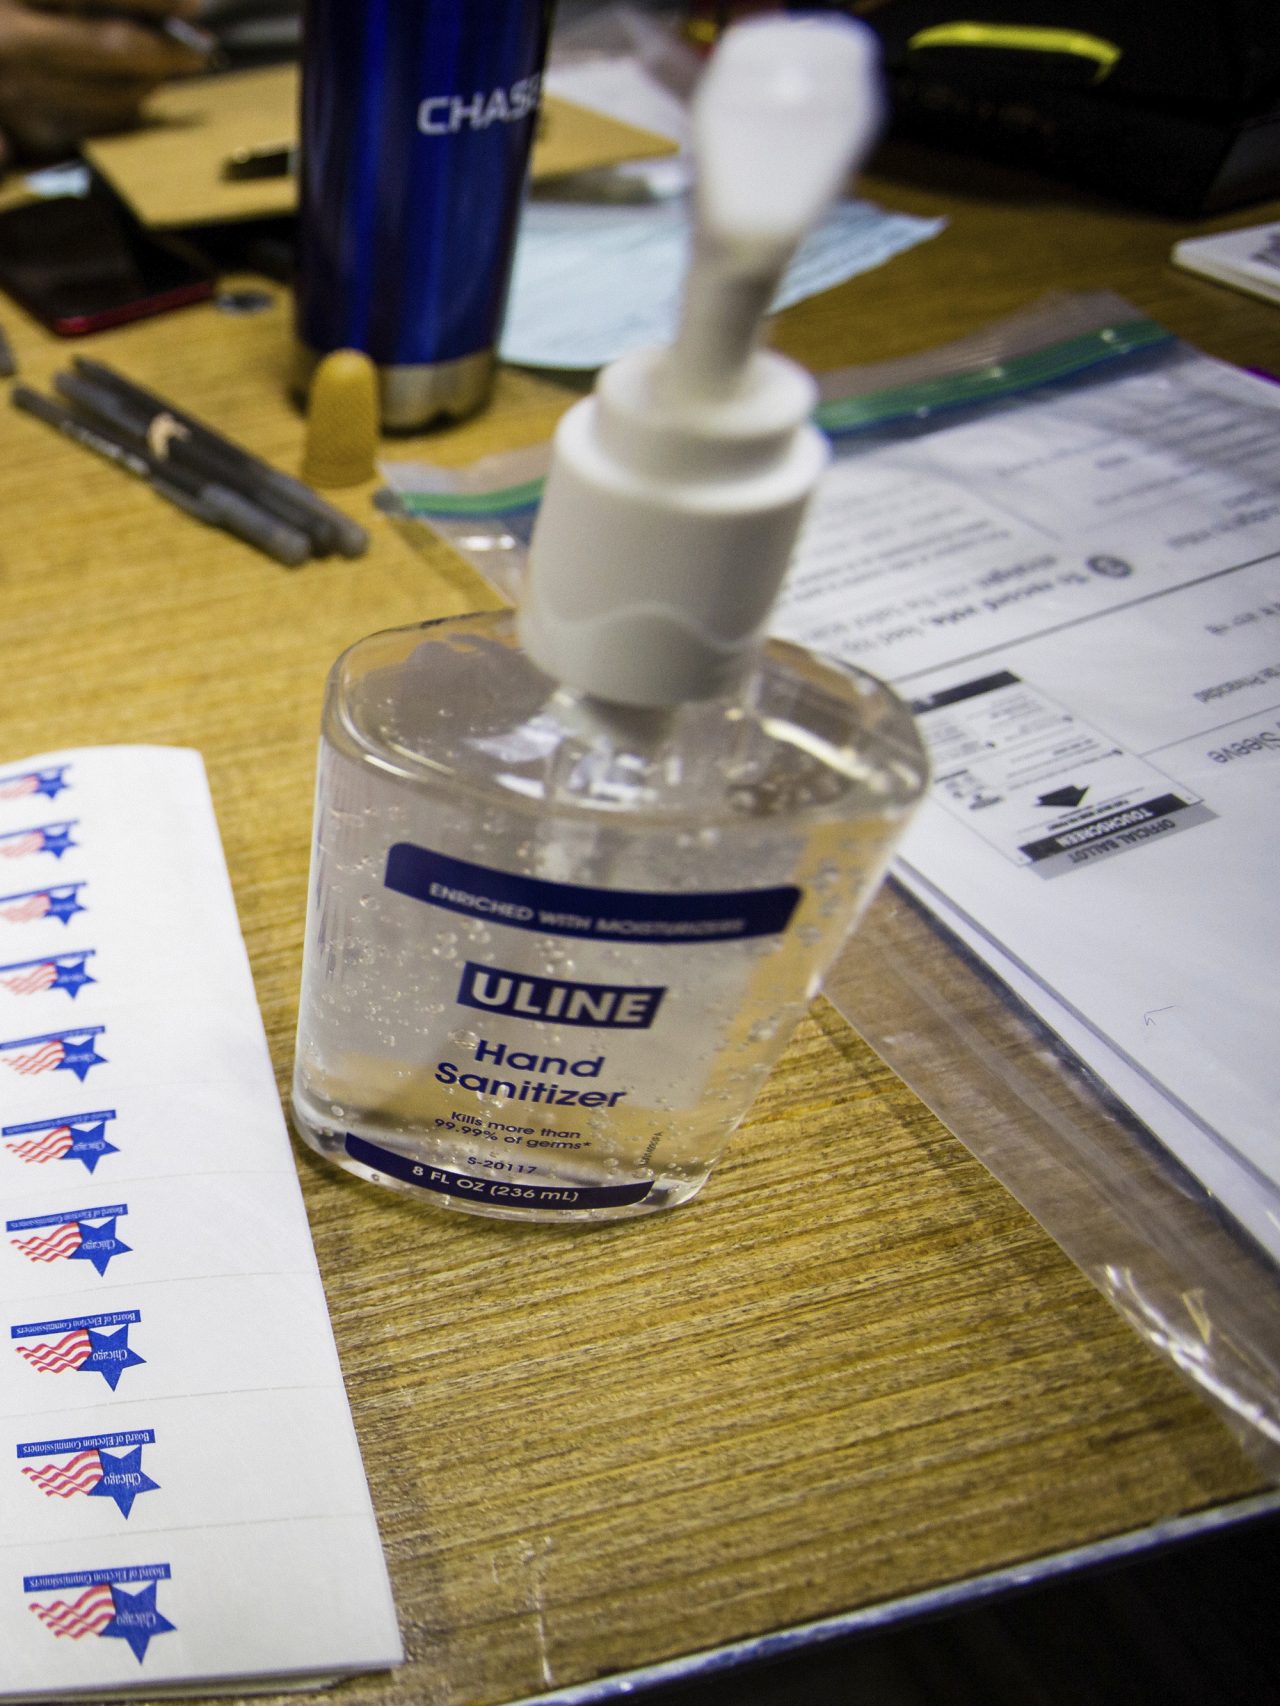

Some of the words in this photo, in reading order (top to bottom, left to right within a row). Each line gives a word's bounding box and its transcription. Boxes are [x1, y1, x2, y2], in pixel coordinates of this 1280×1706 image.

[1055, 808, 1154, 847] TOUCHSCREEN
[1118, 818, 1176, 845] OFFICIAL
[1065, 838, 1116, 864] BALLOT
[429, 881, 534, 921] ENRICHED
[538, 909, 592, 931] WITH
[471, 971, 653, 1024] ULINE
[474, 1039, 605, 1078] Hand
[434, 1062, 627, 1108] Sanitizer
[434, 1117, 498, 1142] 99.99%
[503, 1132, 522, 1145] of
[451, 1111, 483, 1127] Kills
[488, 1121, 535, 1139] more
[540, 1127, 581, 1140] than
[467, 1156, 537, 1174] S-20117
[412, 1165, 424, 1177] 8
[431, 1170, 450, 1186] FL
[455, 1178, 484, 1192] OZ
[490, 1184, 535, 1200] (236
[539, 1189, 579, 1203] mL)
[82, 1239, 116, 1251] Chicago
[73, 1316, 102, 1327] Election
[112, 1313, 135, 1323] Board
[16, 1321, 72, 1335] Commissioners
[92, 1349, 128, 1361] Chicago
[82, 1436, 114, 1448] Election
[126, 1432, 150, 1444] Board
[23, 1440, 81, 1455] Commissioners
[104, 1473, 141, 1487] Chicago
[93, 1570, 126, 1583] Election
[138, 1566, 165, 1578] Board
[29, 1574, 92, 1588] Commissioners
